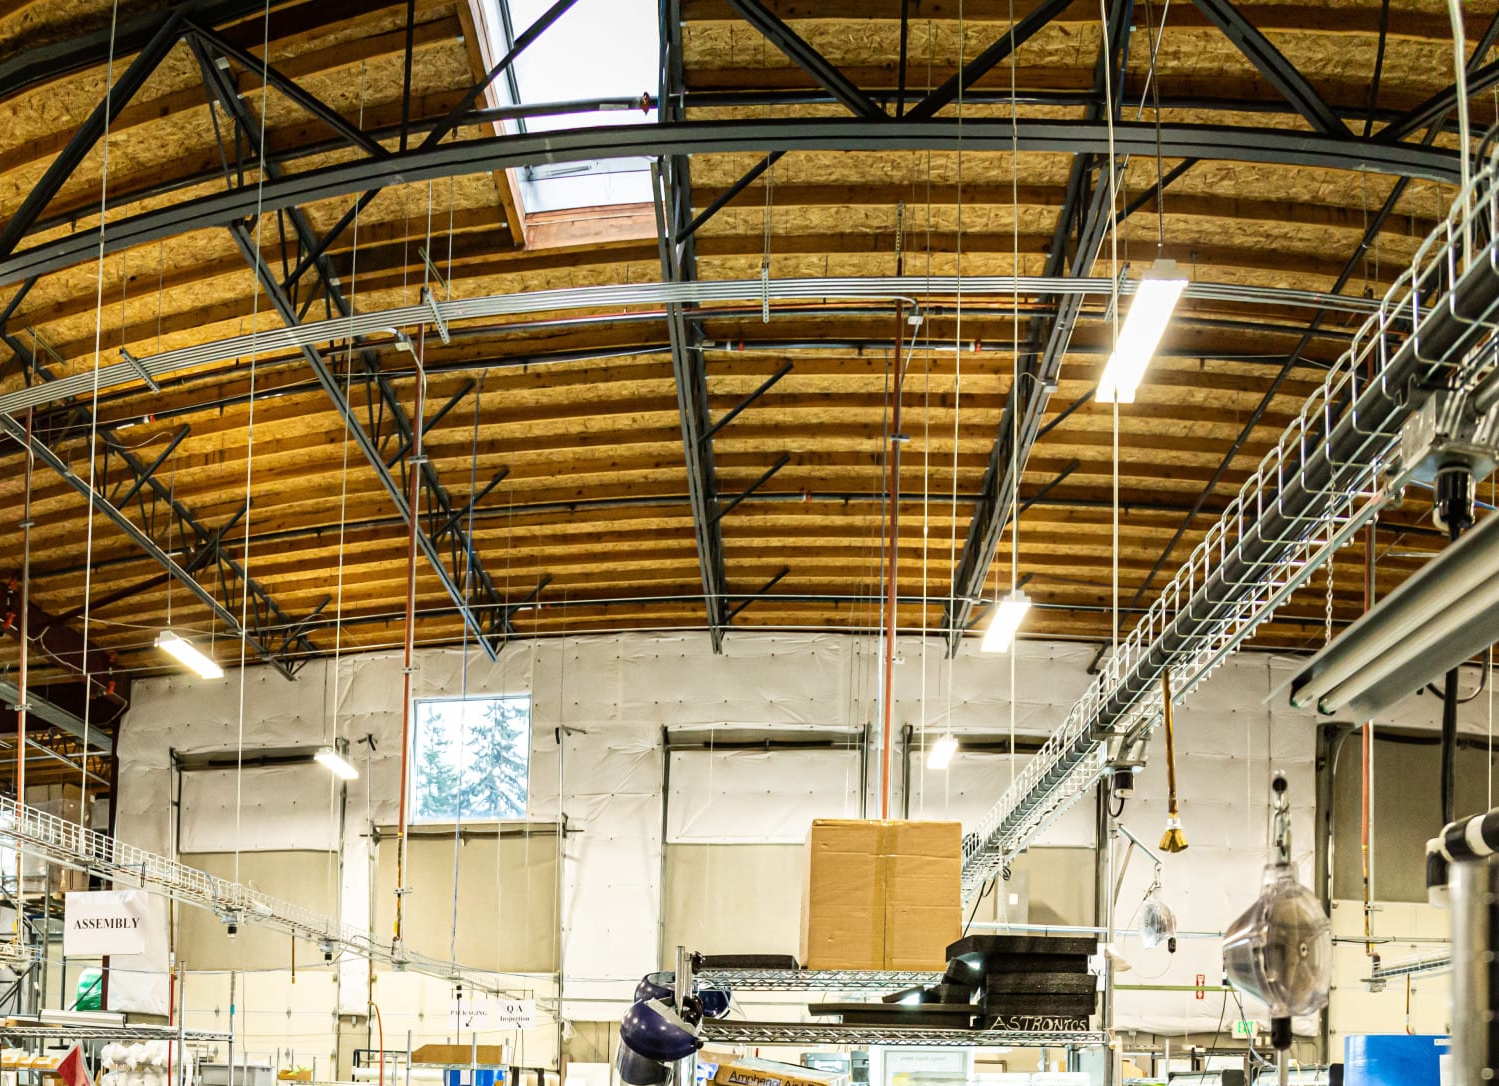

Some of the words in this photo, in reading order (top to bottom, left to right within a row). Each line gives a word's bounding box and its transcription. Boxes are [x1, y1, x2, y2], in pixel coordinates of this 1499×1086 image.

[73, 917, 140, 929] ASSEMBLY
[500, 1015, 530, 1023] Inspection
[989, 1015, 1088, 1031] ASTRONICS
